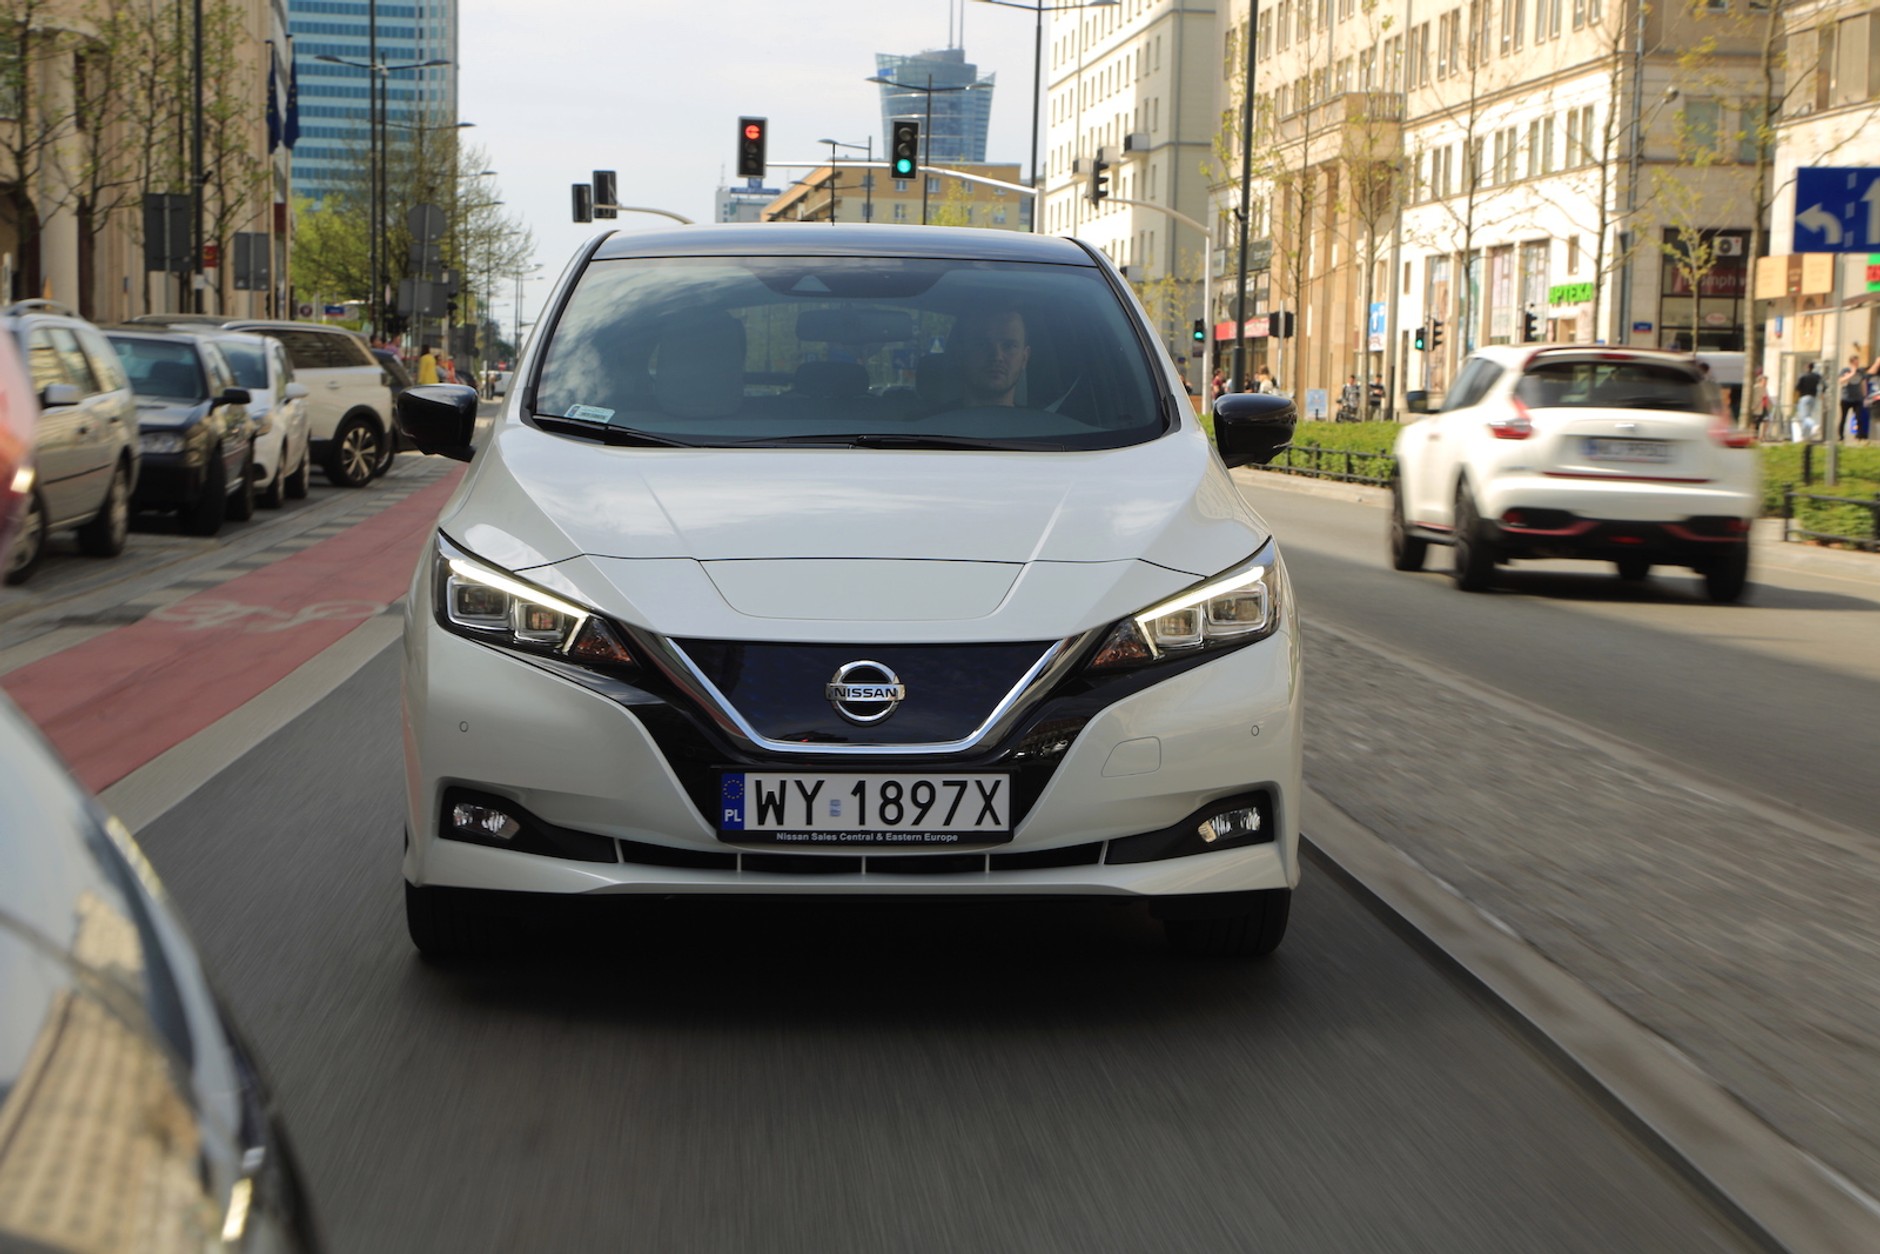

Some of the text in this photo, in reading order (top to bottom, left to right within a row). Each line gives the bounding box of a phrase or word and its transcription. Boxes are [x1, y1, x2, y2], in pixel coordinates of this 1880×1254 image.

[834, 687, 897, 698] NISSAN
[755, 779, 1002, 826] WY 1897X
[724, 809, 742, 822] PL
[776, 832, 959, 843] Nissan Sales Central & Eastern Europe
